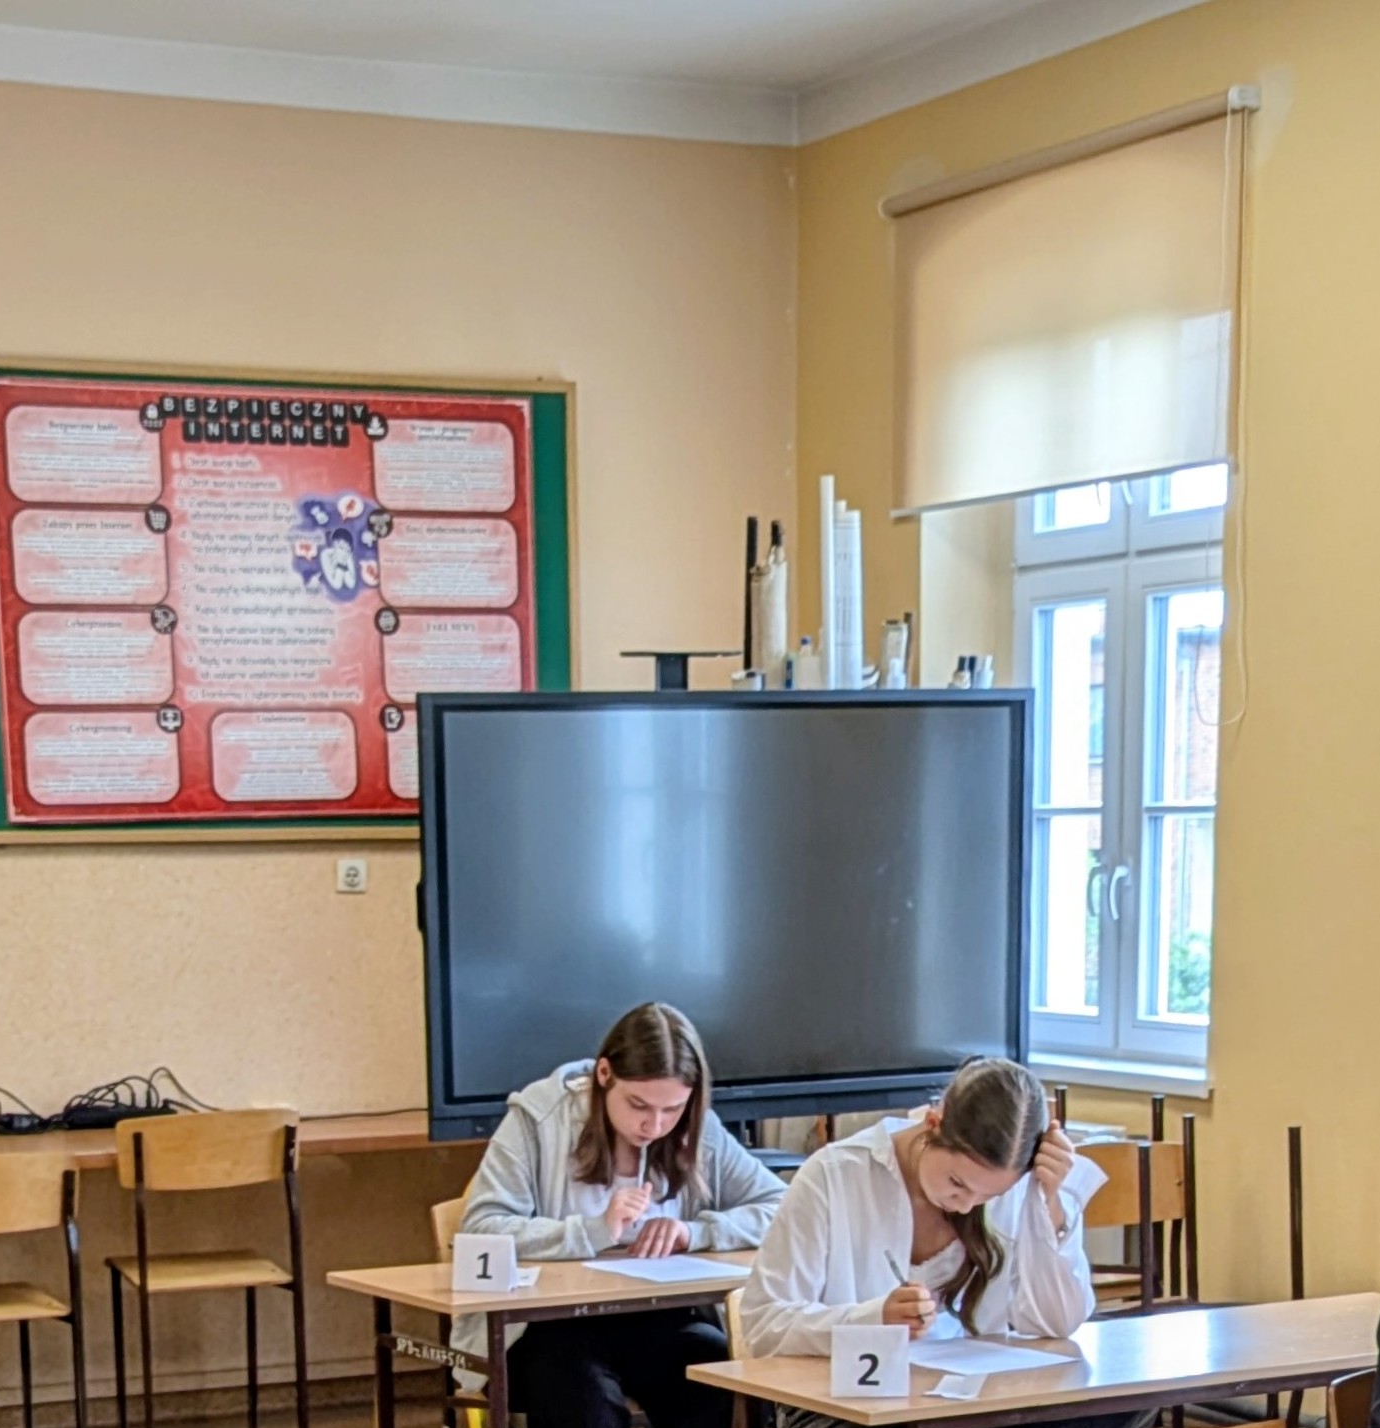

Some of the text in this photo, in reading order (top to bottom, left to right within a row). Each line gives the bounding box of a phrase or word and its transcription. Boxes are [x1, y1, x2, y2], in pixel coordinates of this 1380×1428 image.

[162, 397, 366, 418] BEZPIECZNY
[188, 422, 343, 441] INTERNET
[475, 1252, 493, 1280] 1
[857, 1353, 880, 1386] 2
